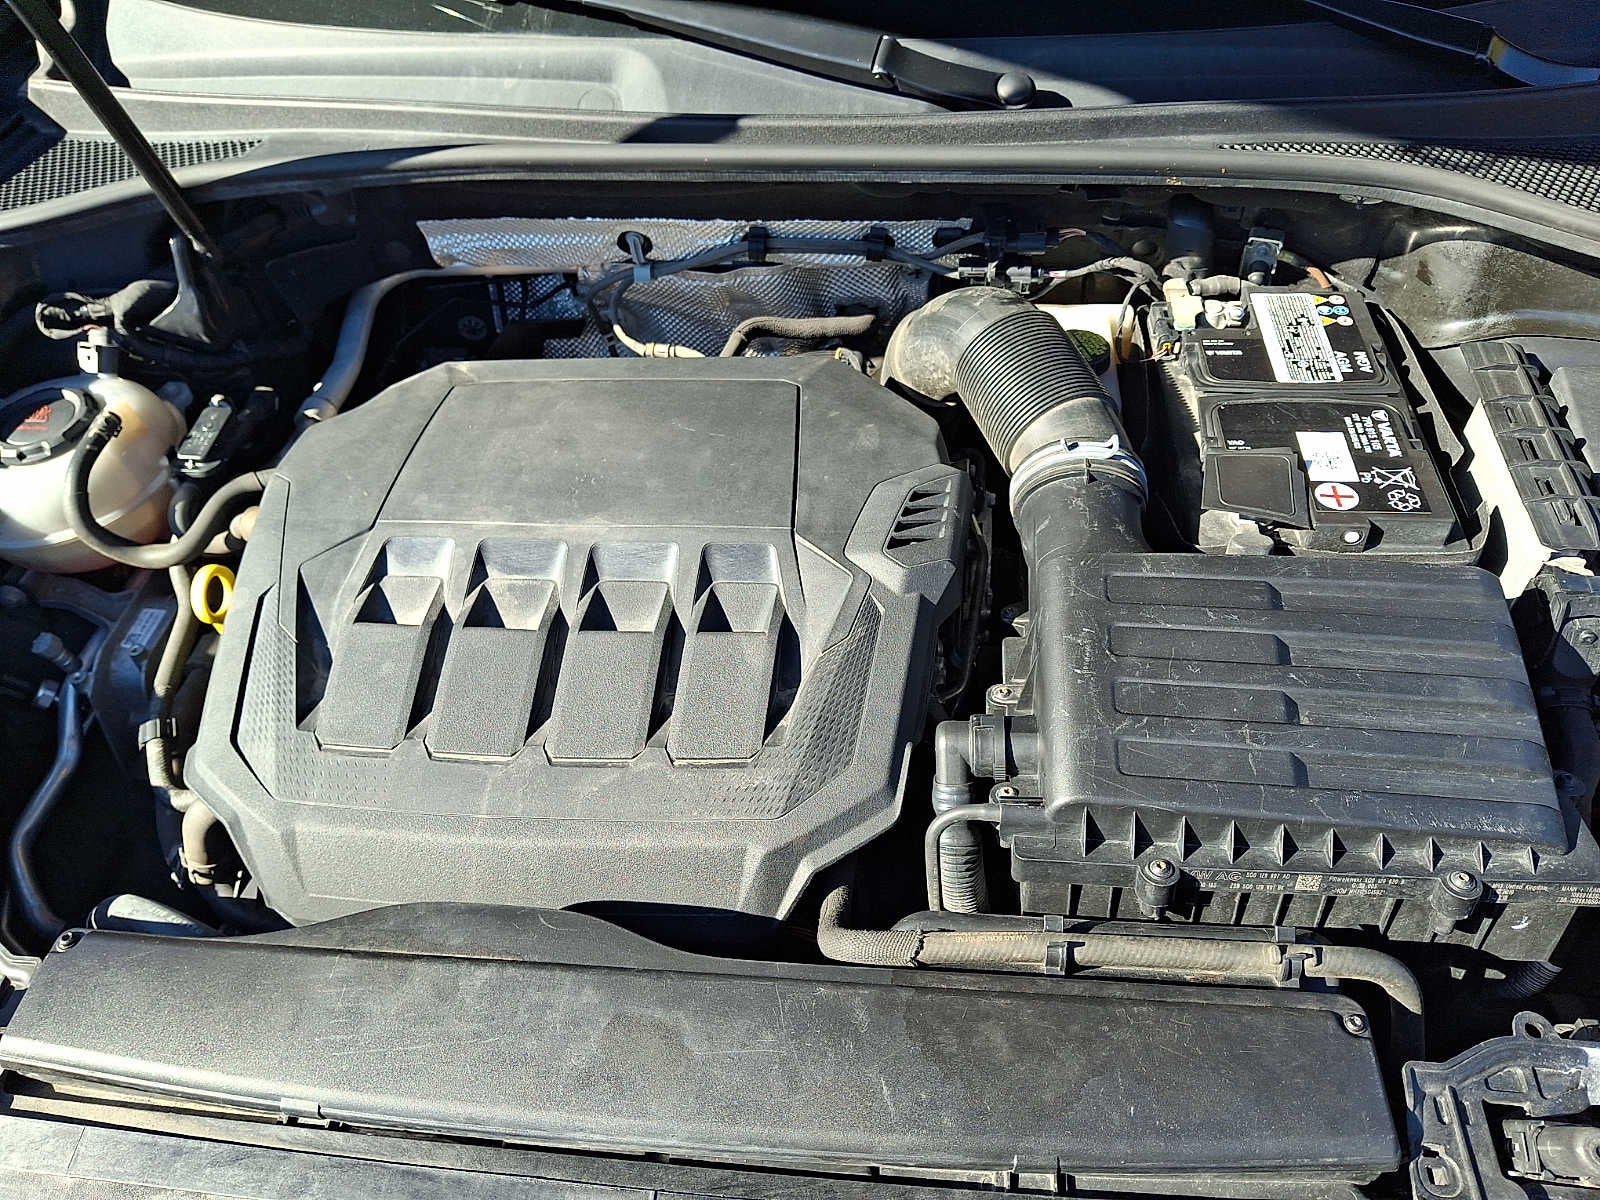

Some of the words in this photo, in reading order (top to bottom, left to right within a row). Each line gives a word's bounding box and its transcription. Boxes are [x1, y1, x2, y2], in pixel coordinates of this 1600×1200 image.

[1333, 350, 1354, 373] AGM
[1353, 351, 1374, 374] AGM
[1378, 421, 1403, 458] VARTA
[1359, 471, 1373, 484] Pb
[1215, 871, 1242, 881] AG
